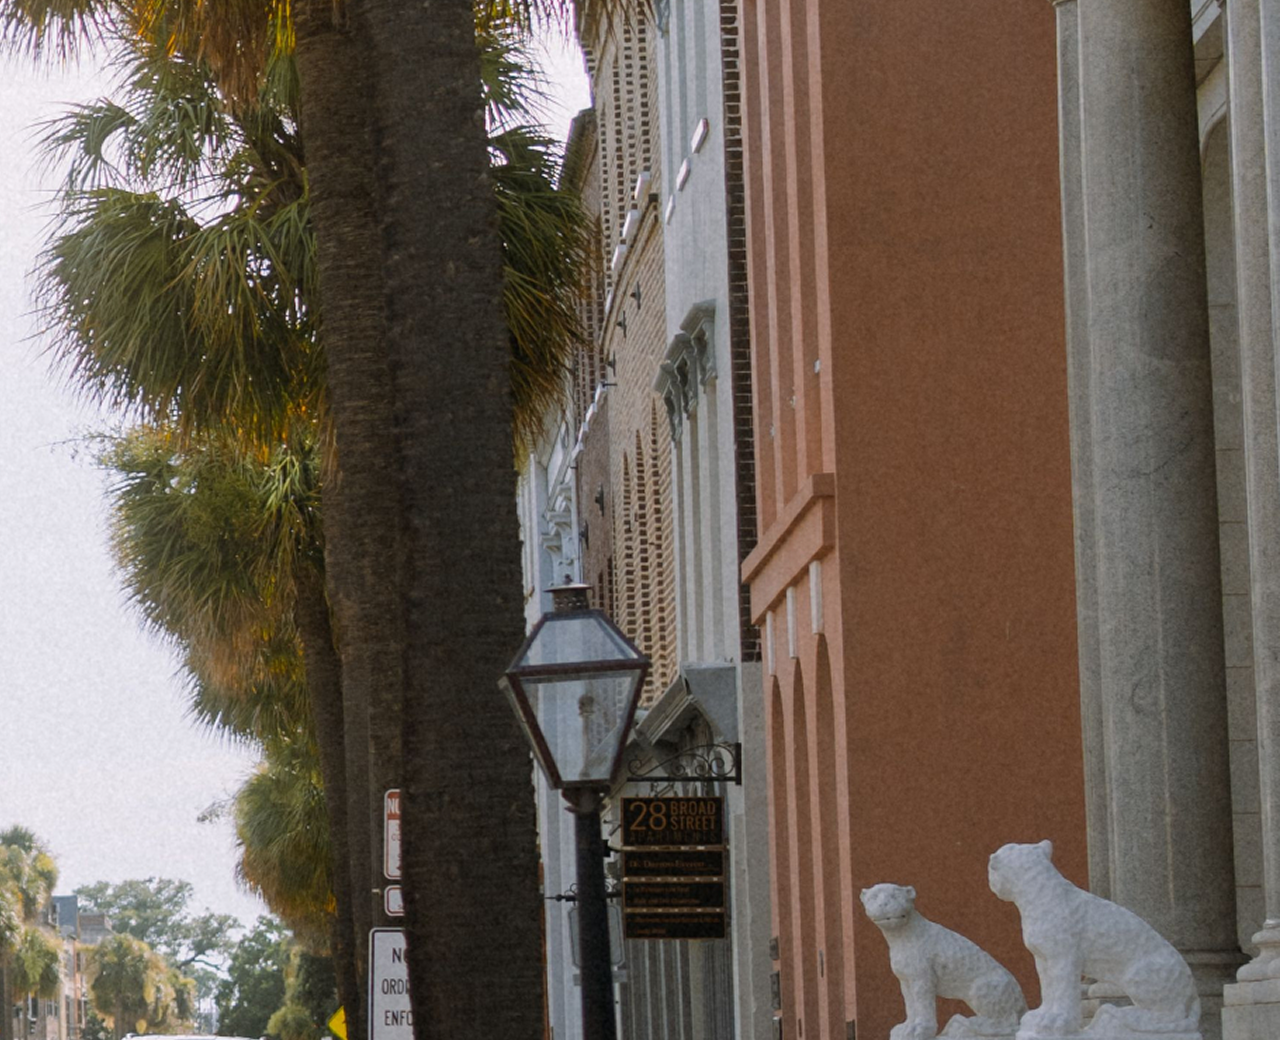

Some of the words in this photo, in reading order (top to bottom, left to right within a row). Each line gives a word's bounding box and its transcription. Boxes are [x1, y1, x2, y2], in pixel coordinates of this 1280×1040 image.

[630, 801, 667, 830] 28
[671, 801, 716, 815] BROAD
[671, 816, 716, 830] STREET
